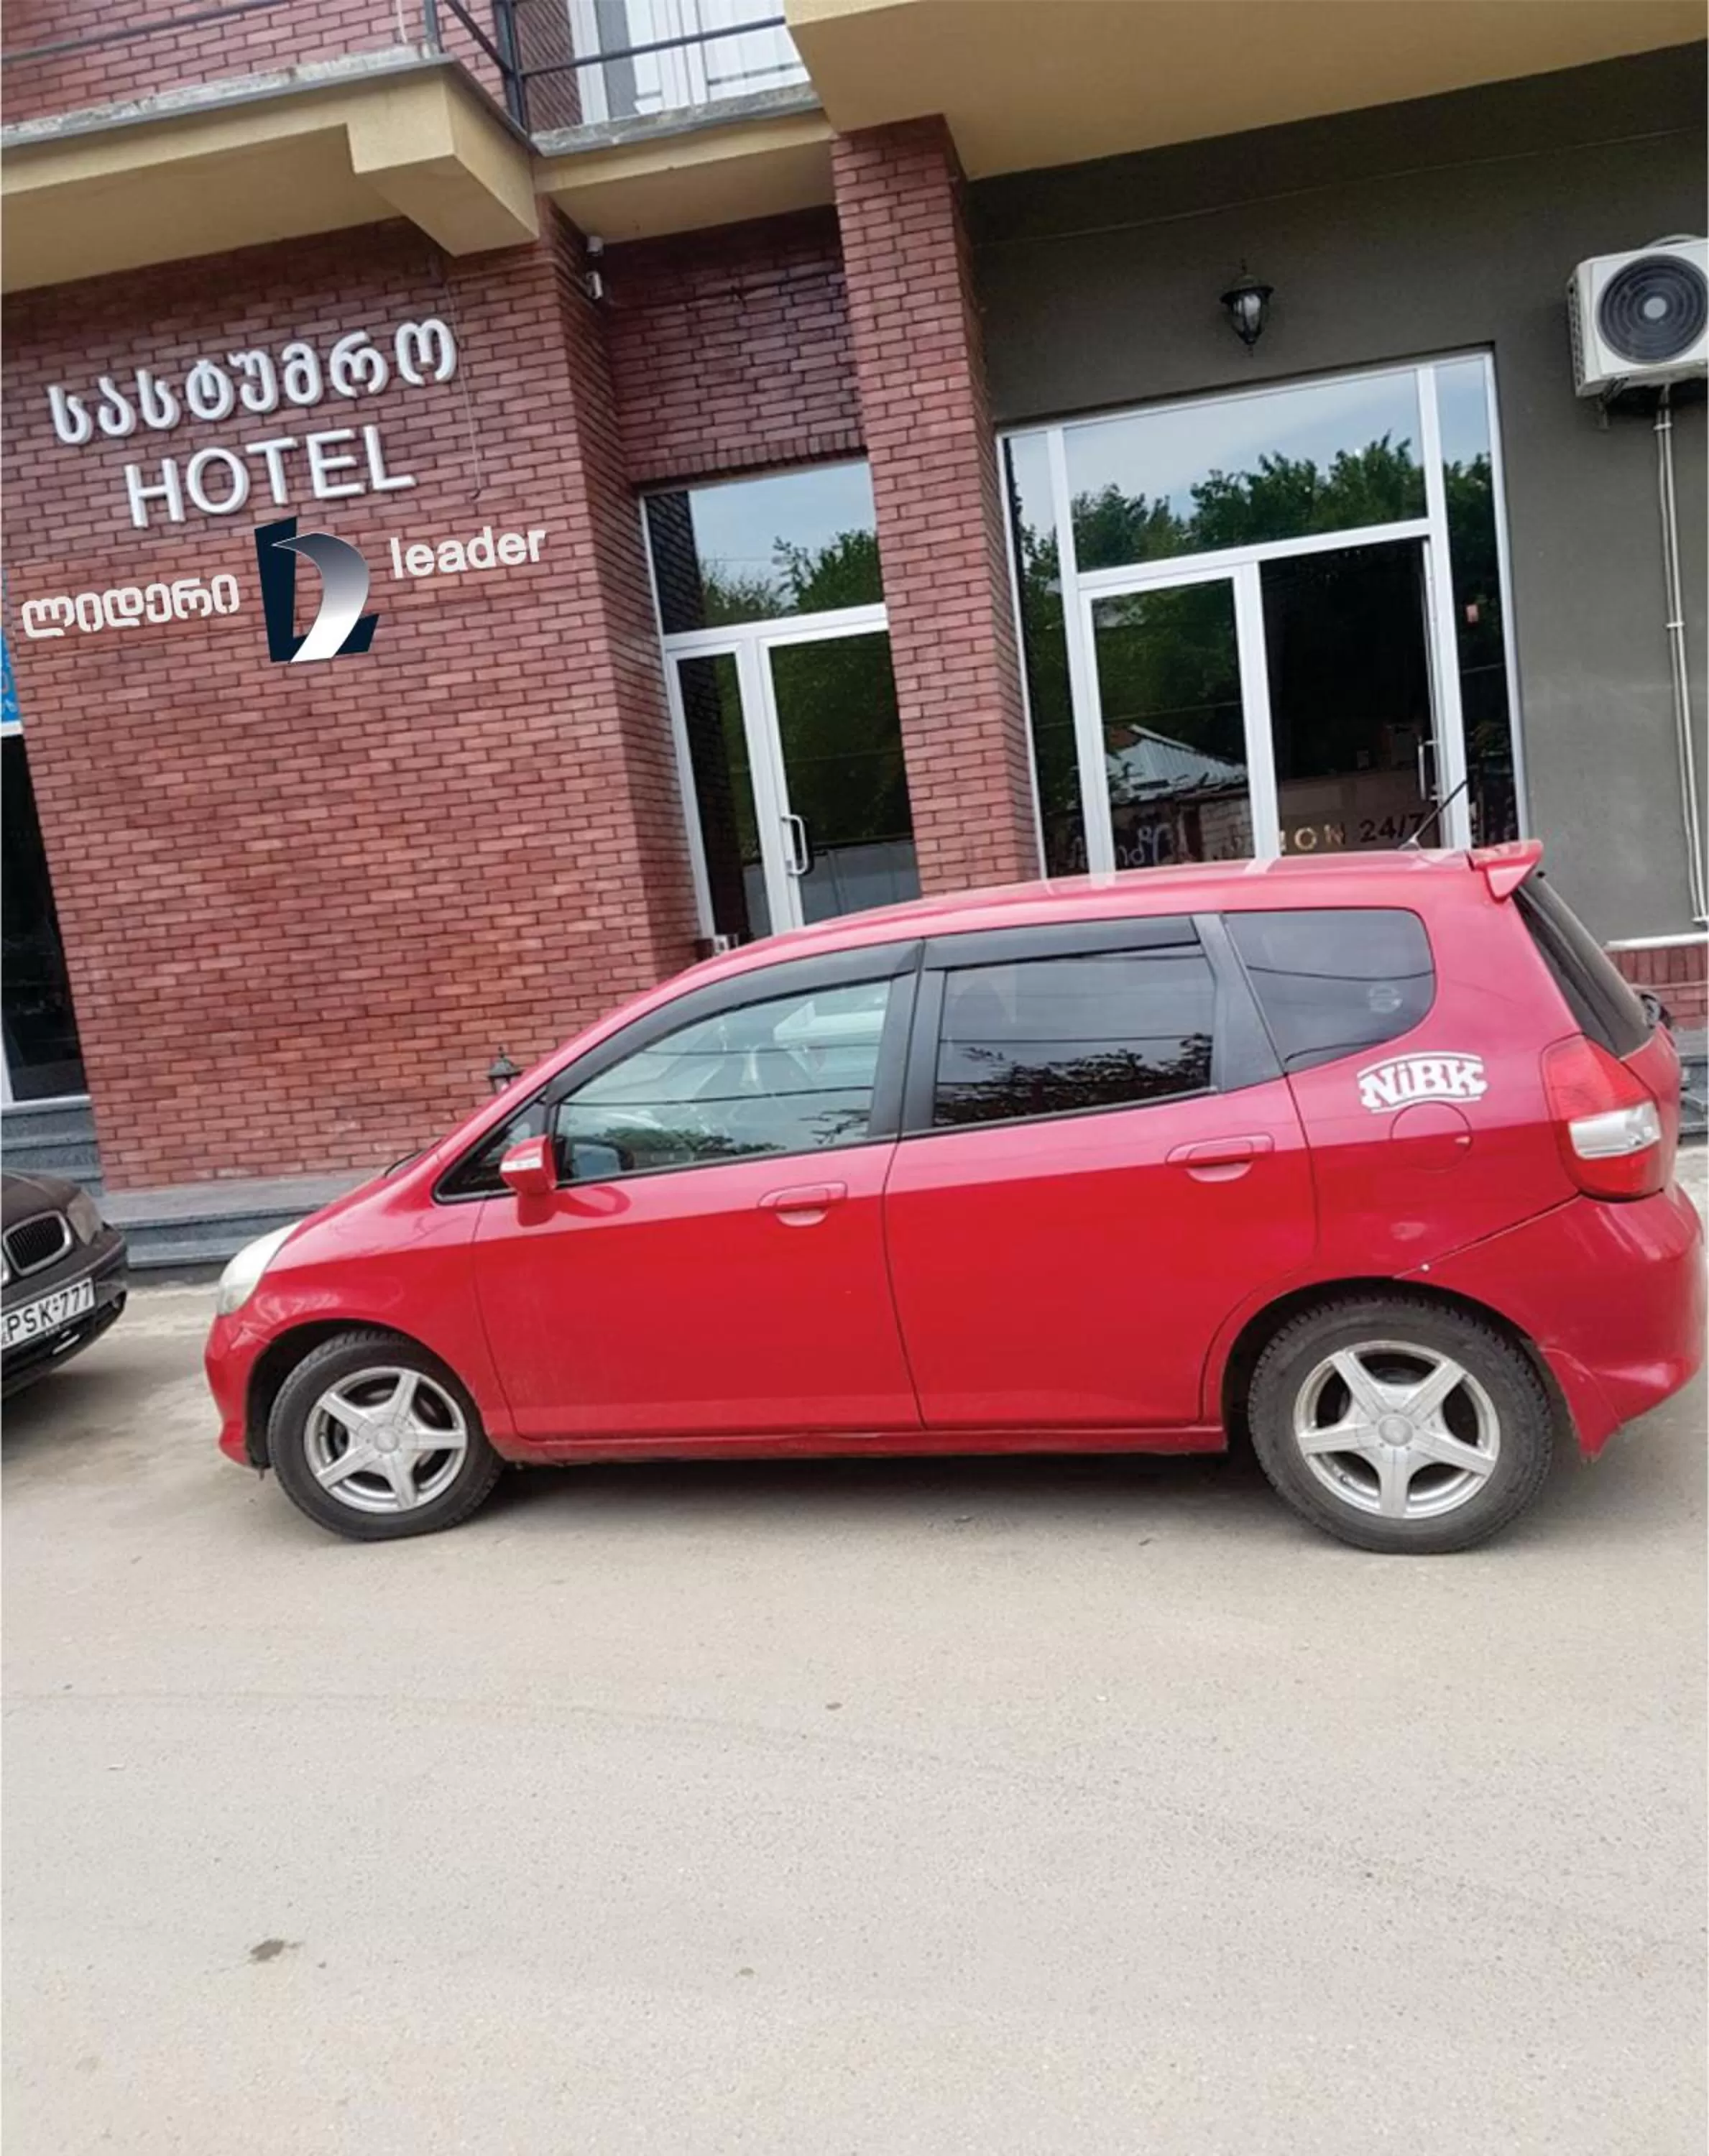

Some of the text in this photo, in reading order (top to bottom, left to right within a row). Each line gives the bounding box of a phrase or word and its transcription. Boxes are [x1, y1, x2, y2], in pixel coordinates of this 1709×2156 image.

[47, 318, 459, 446] სასტუმრო
[124, 424, 418, 528] HOTEL
[390, 526, 547, 579] leader
[22, 573, 241, 640] ლიდერი
